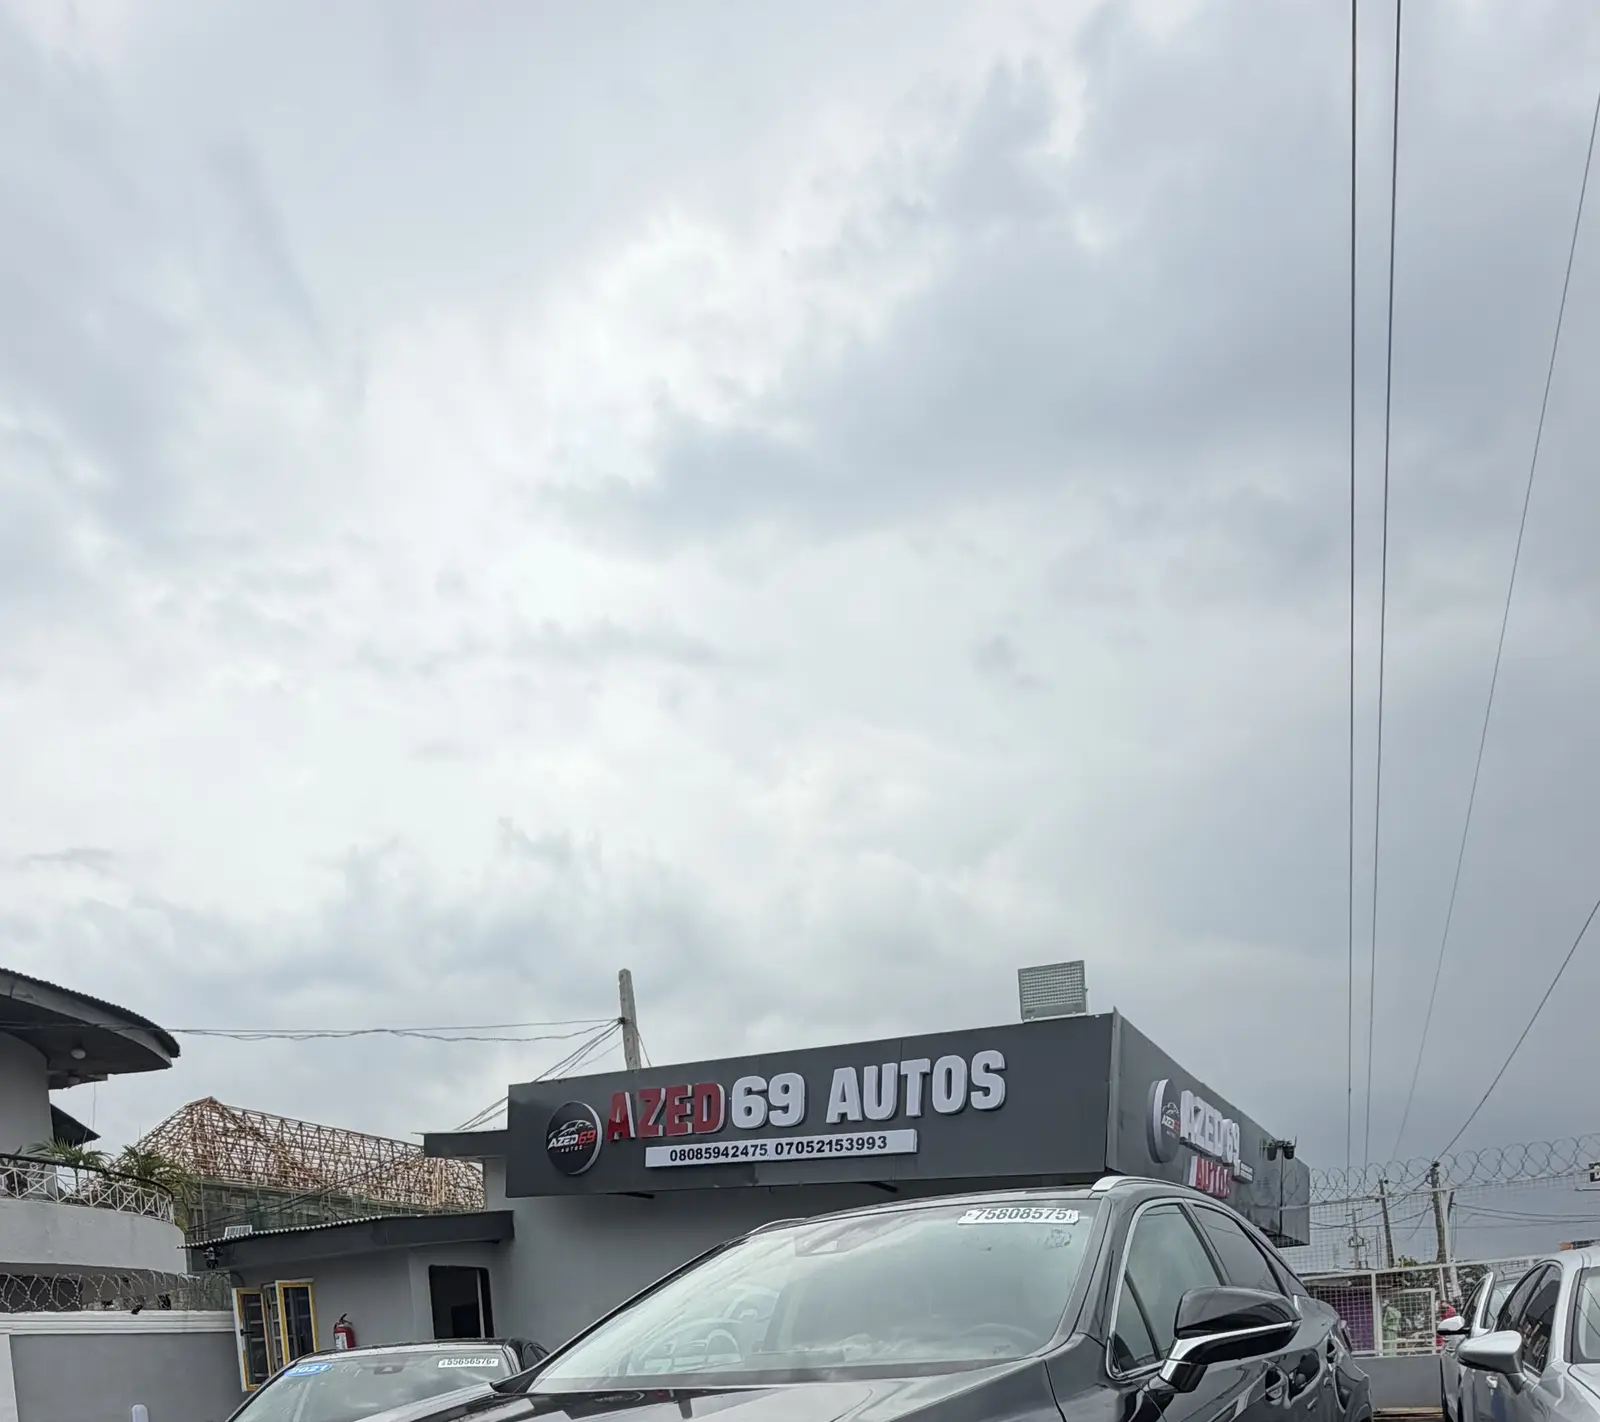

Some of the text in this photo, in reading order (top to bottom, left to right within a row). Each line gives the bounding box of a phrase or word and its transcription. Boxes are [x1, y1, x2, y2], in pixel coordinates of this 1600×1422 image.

[826, 1050, 1006, 1123] AUTOS
[669, 1135, 888, 1161] 08085942475 07052153993
